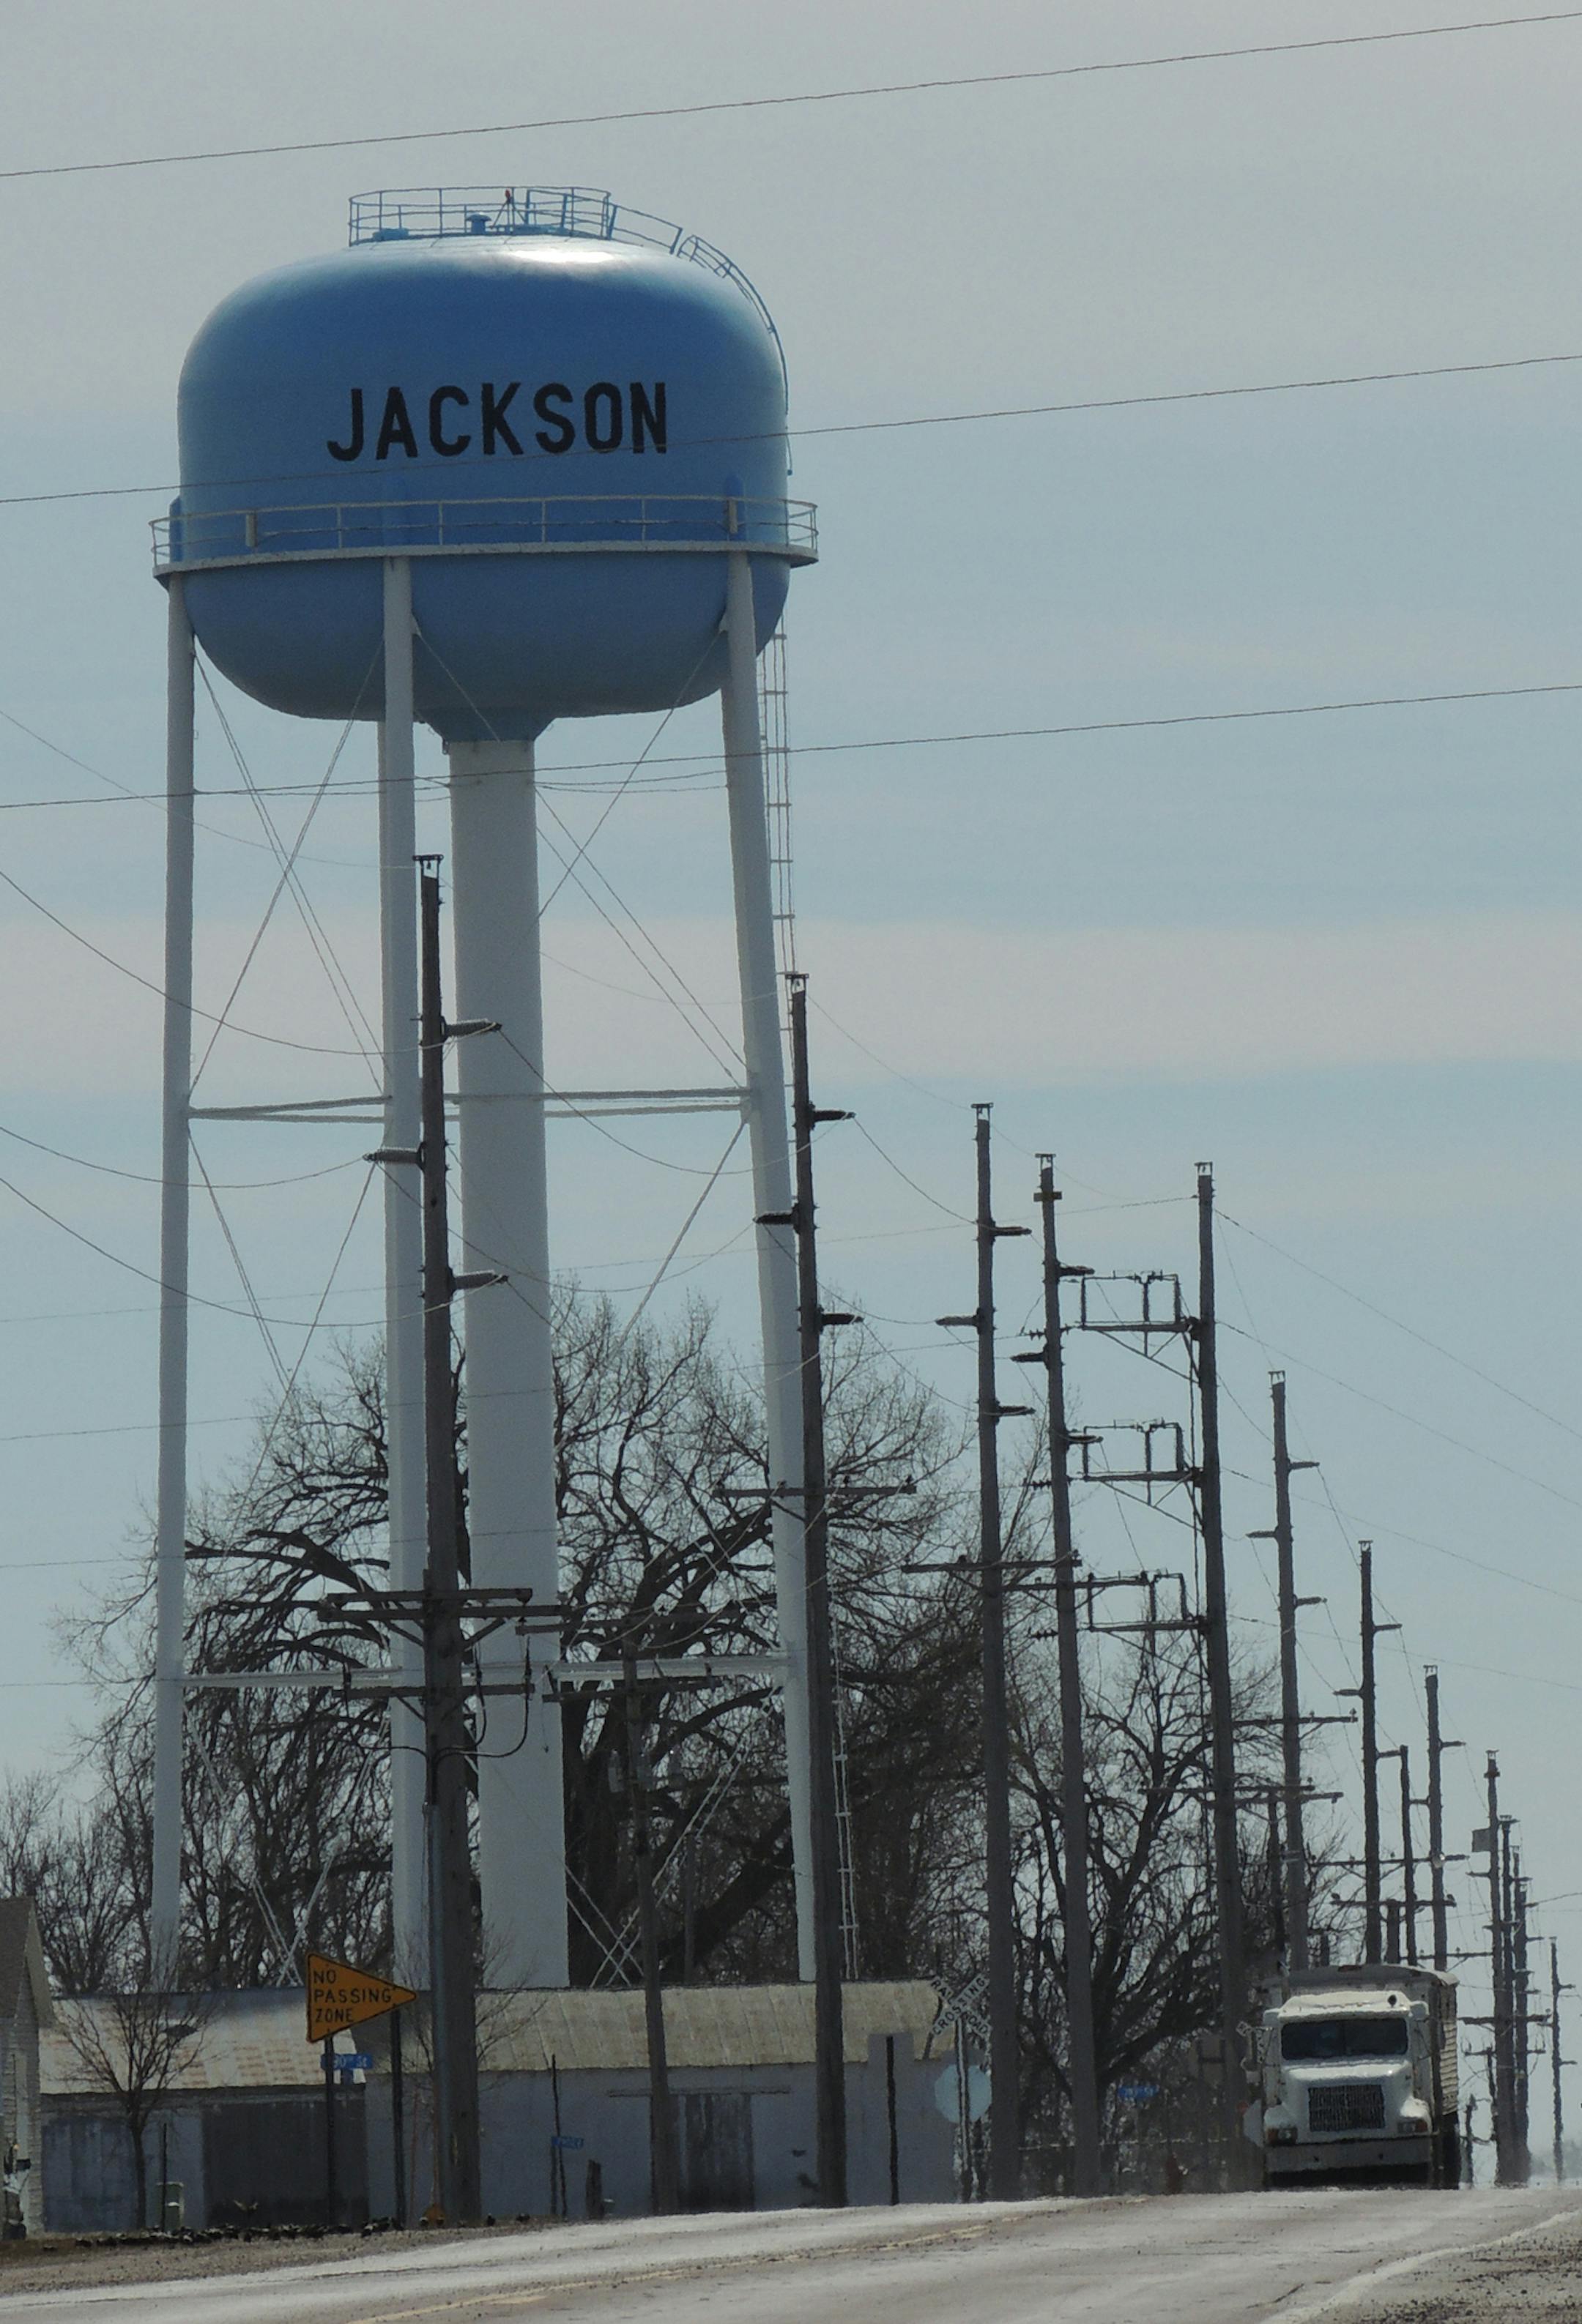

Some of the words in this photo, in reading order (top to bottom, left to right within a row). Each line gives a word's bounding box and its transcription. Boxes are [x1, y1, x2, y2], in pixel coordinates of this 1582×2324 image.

[327, 381, 666, 461] JACKSON
[314, 1970, 336, 1984] NO
[314, 1989, 392, 2004] PASSING
[932, 1978, 985, 2035] CROSSING
[316, 2008, 354, 2023] ZONE
